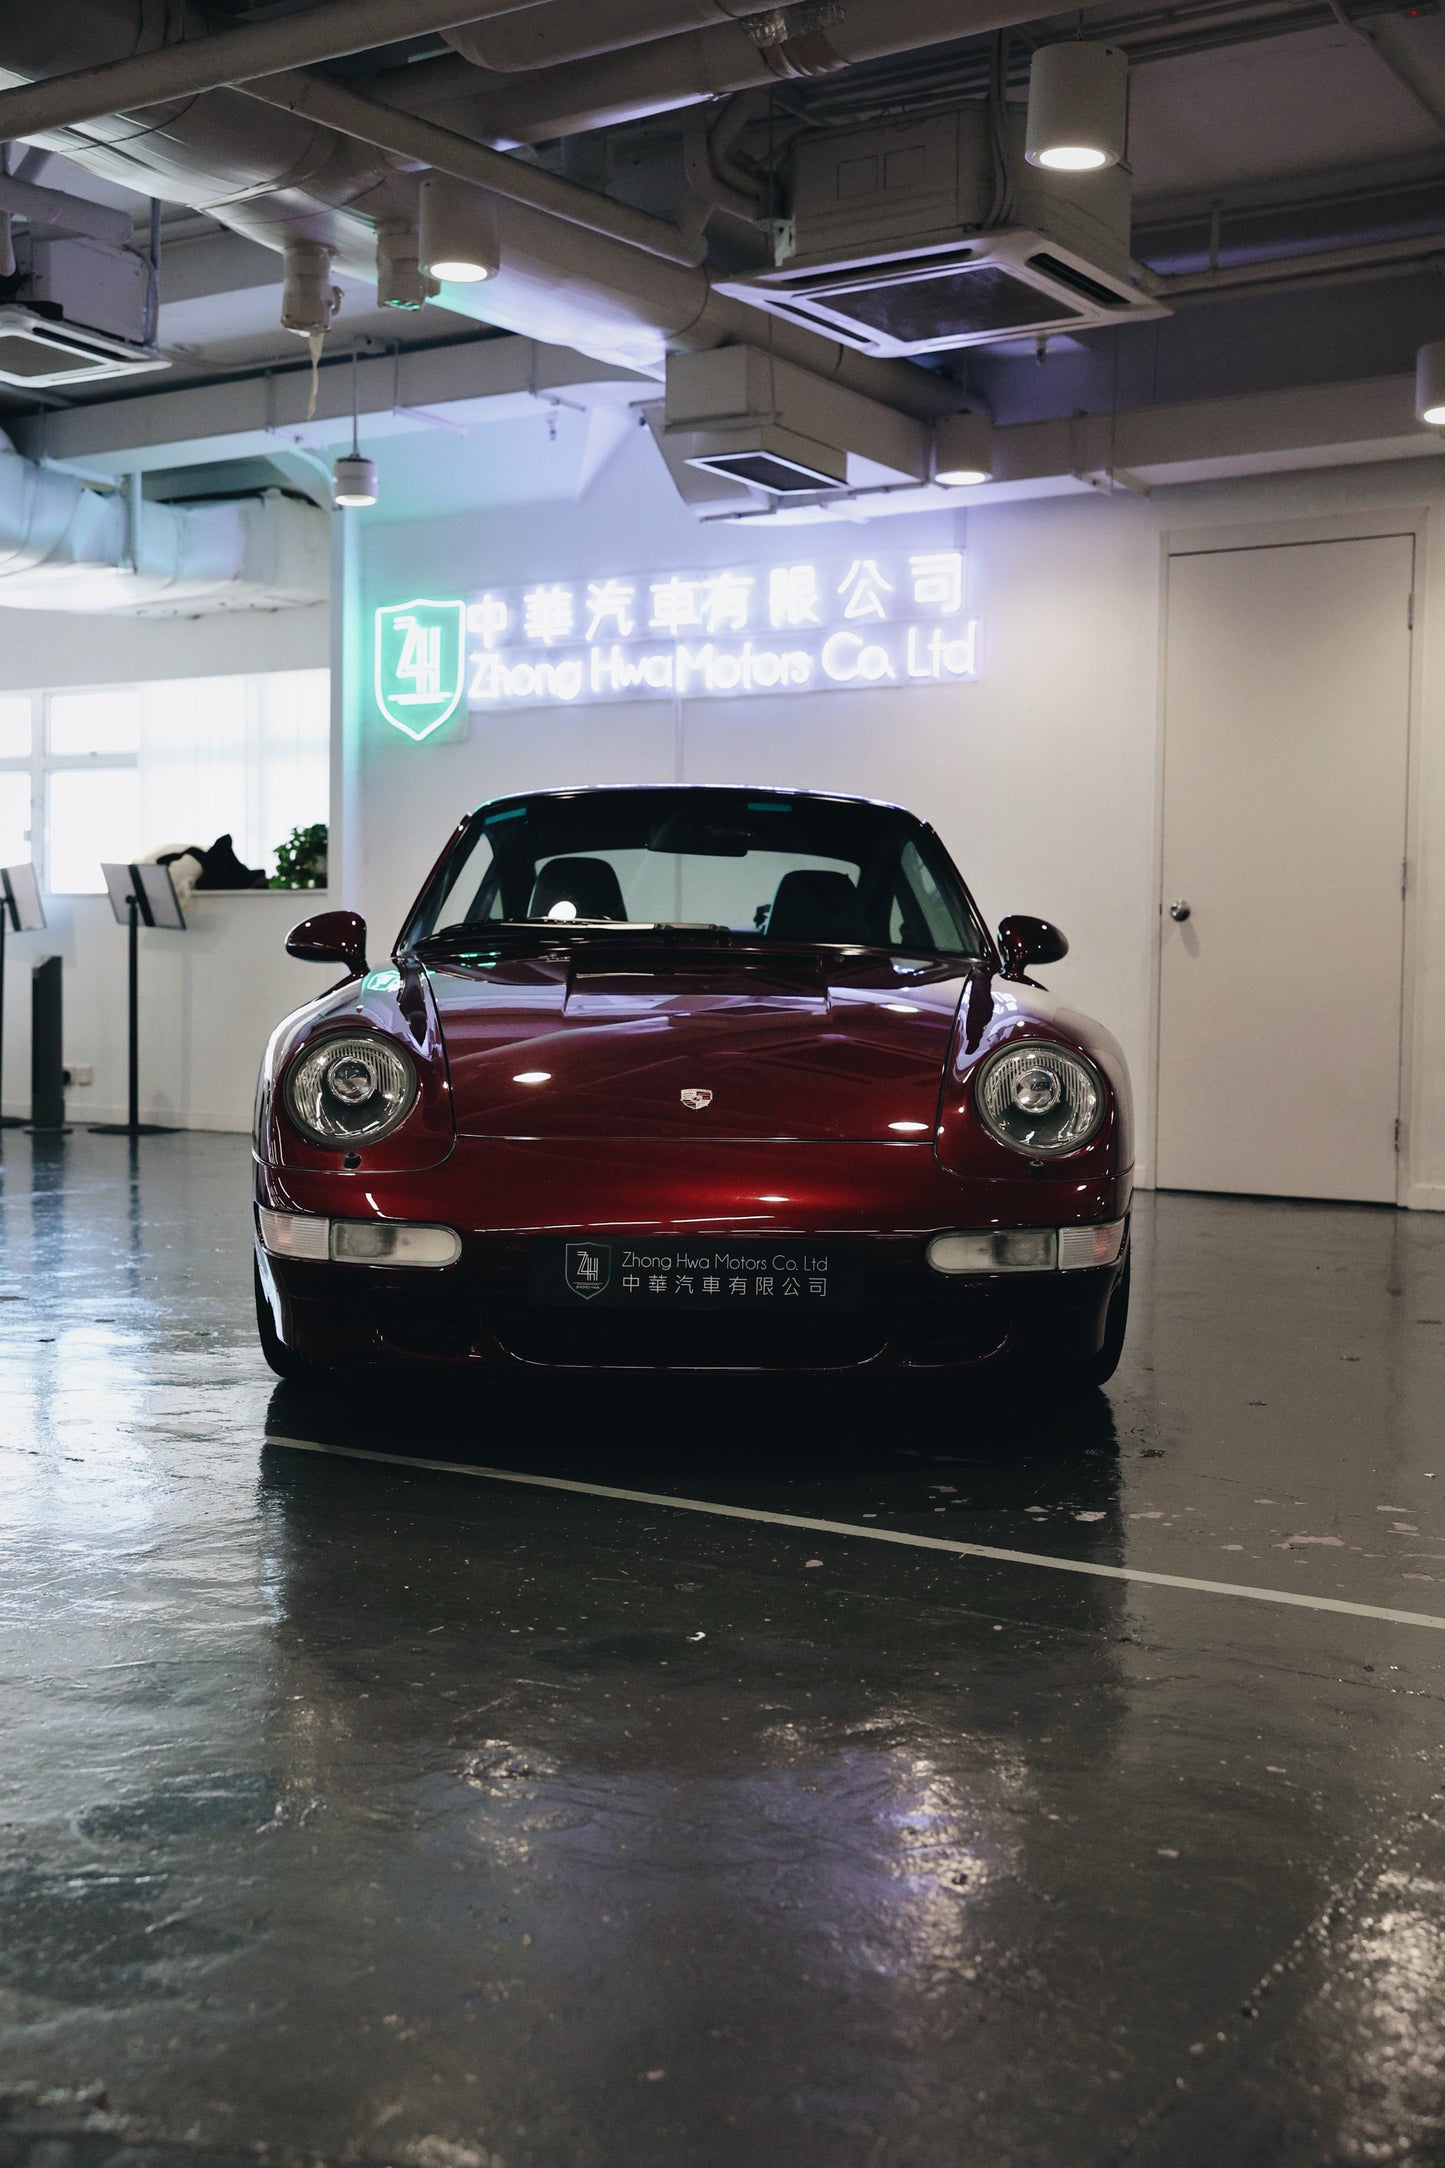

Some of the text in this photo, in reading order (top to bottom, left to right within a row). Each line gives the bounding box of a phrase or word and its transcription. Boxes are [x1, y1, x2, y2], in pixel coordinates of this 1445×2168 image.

[466, 551, 964, 650] 中華汽車有限公司
[468, 652, 582, 700] Zhong
[590, 645, 674, 691] Hwa
[676, 642, 812, 692] Motors
[907, 619, 978, 678] Ltd
[622, 1251, 828, 1272] Zhong Hwa Motors Co. Ltd
[622, 1273, 827, 1297] 中華汽車有限公司
